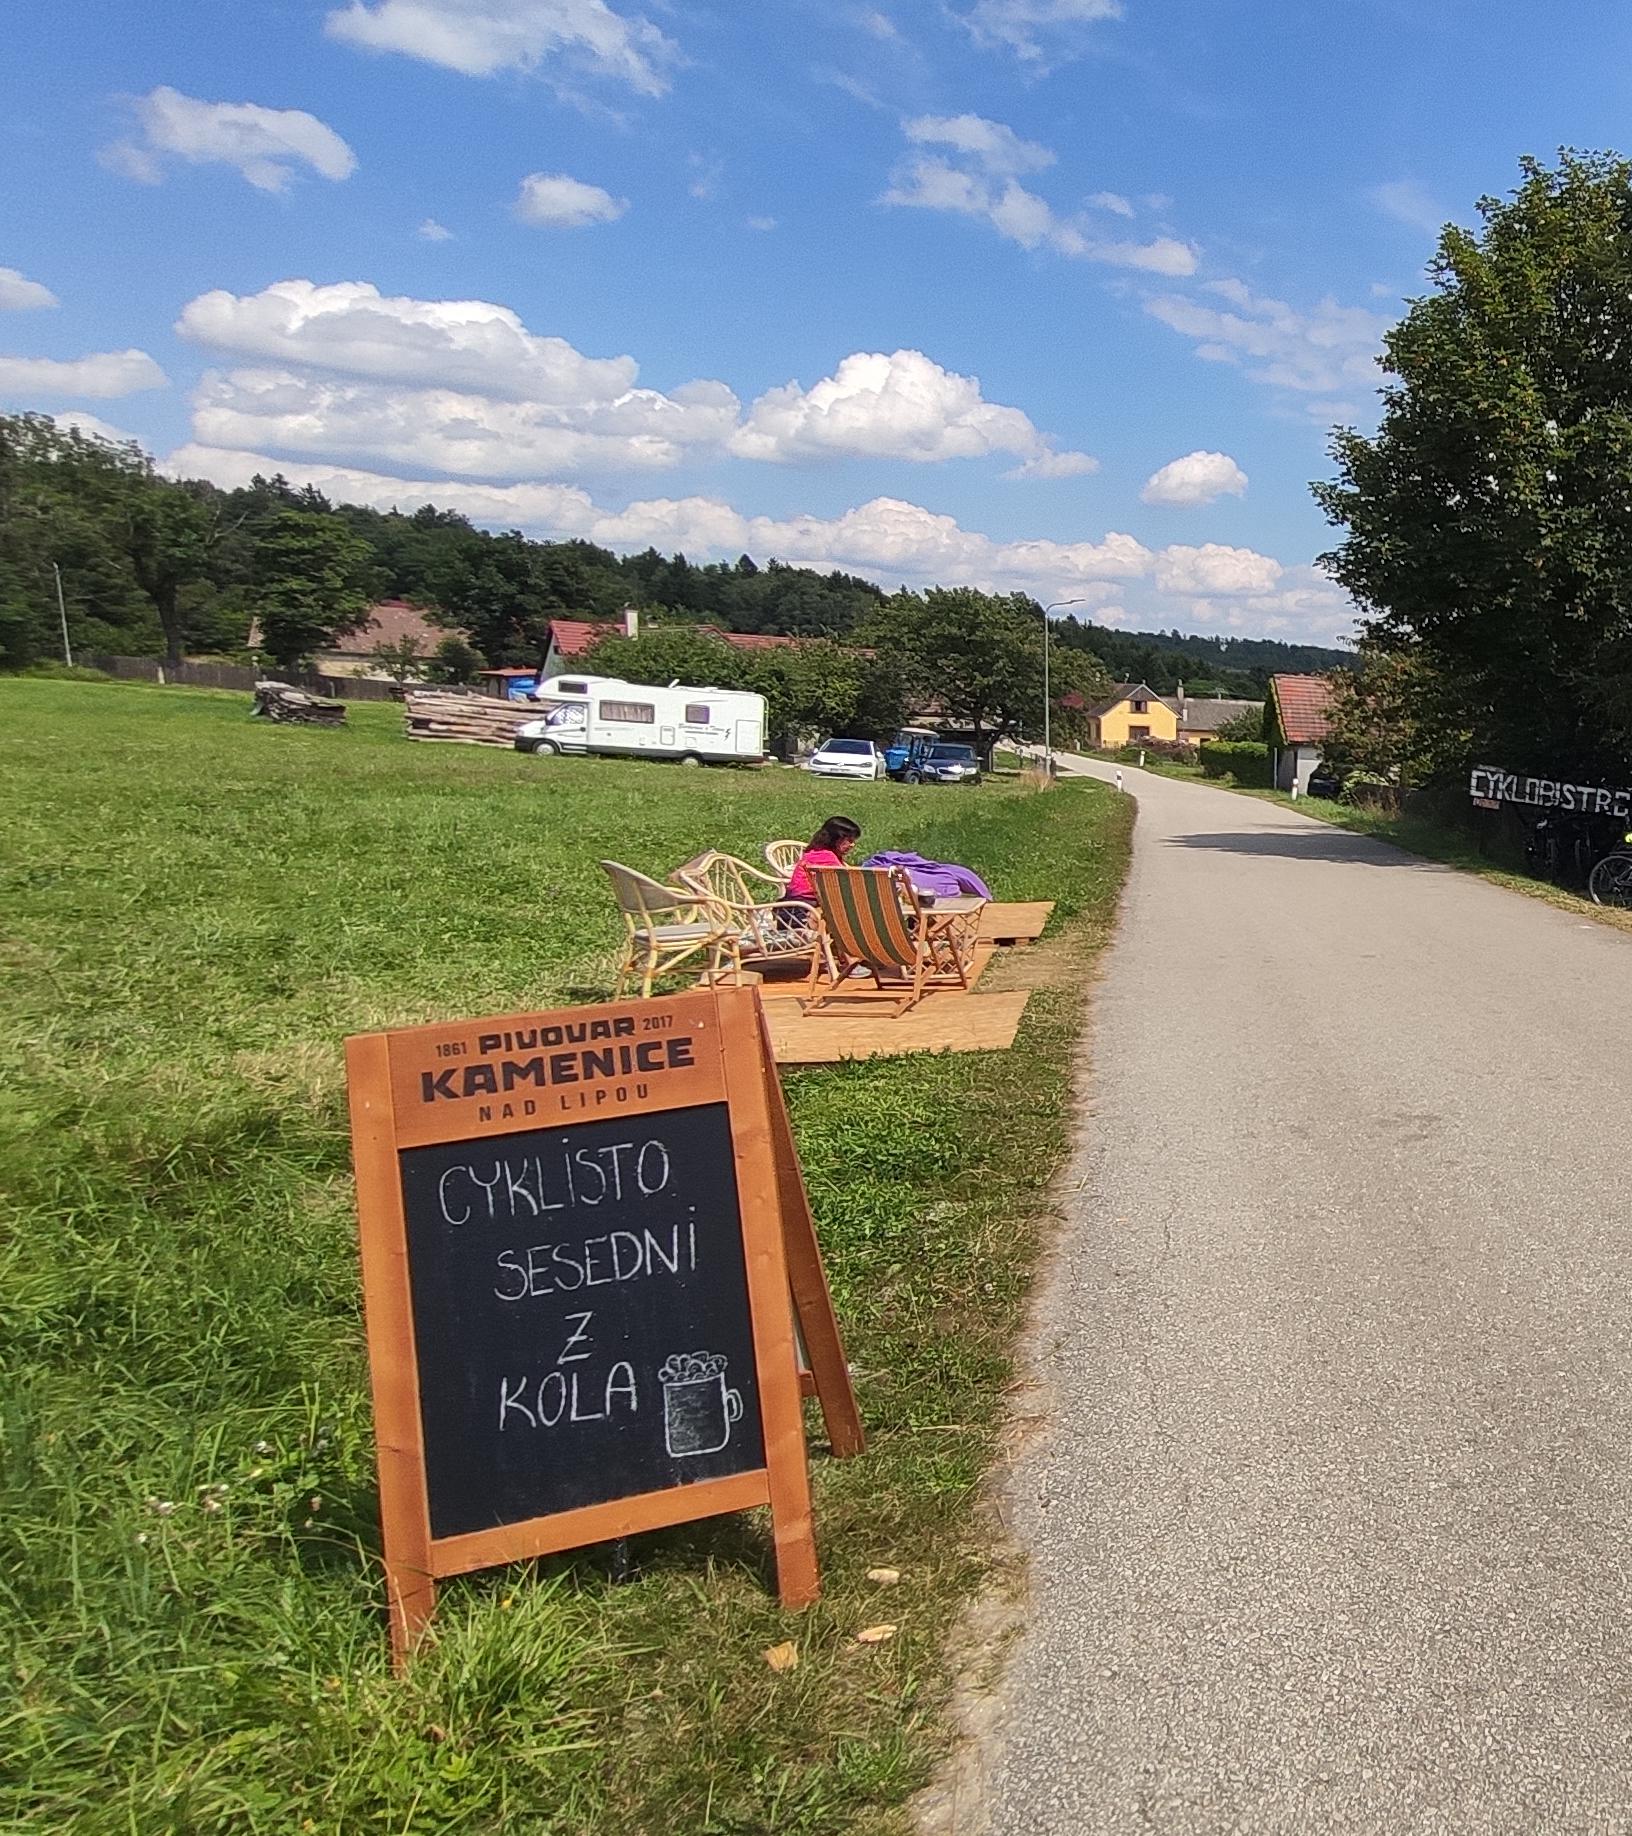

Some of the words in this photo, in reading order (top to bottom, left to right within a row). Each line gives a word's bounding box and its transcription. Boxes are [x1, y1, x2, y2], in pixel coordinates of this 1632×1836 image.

[1470, 770, 1631, 817] CYKLOBISTRO
[435, 1041, 468, 1058] 1861
[479, 1017, 635, 1055] PIVOVAR
[642, 1014, 673, 1032] 2017
[421, 1036, 695, 1103] KAMENICE
[479, 1101, 536, 1122] NAD
[560, 1083, 648, 1111] LIPOU
[556, 1311, 594, 1366] Z
[500, 1360, 638, 1430] KOLA
